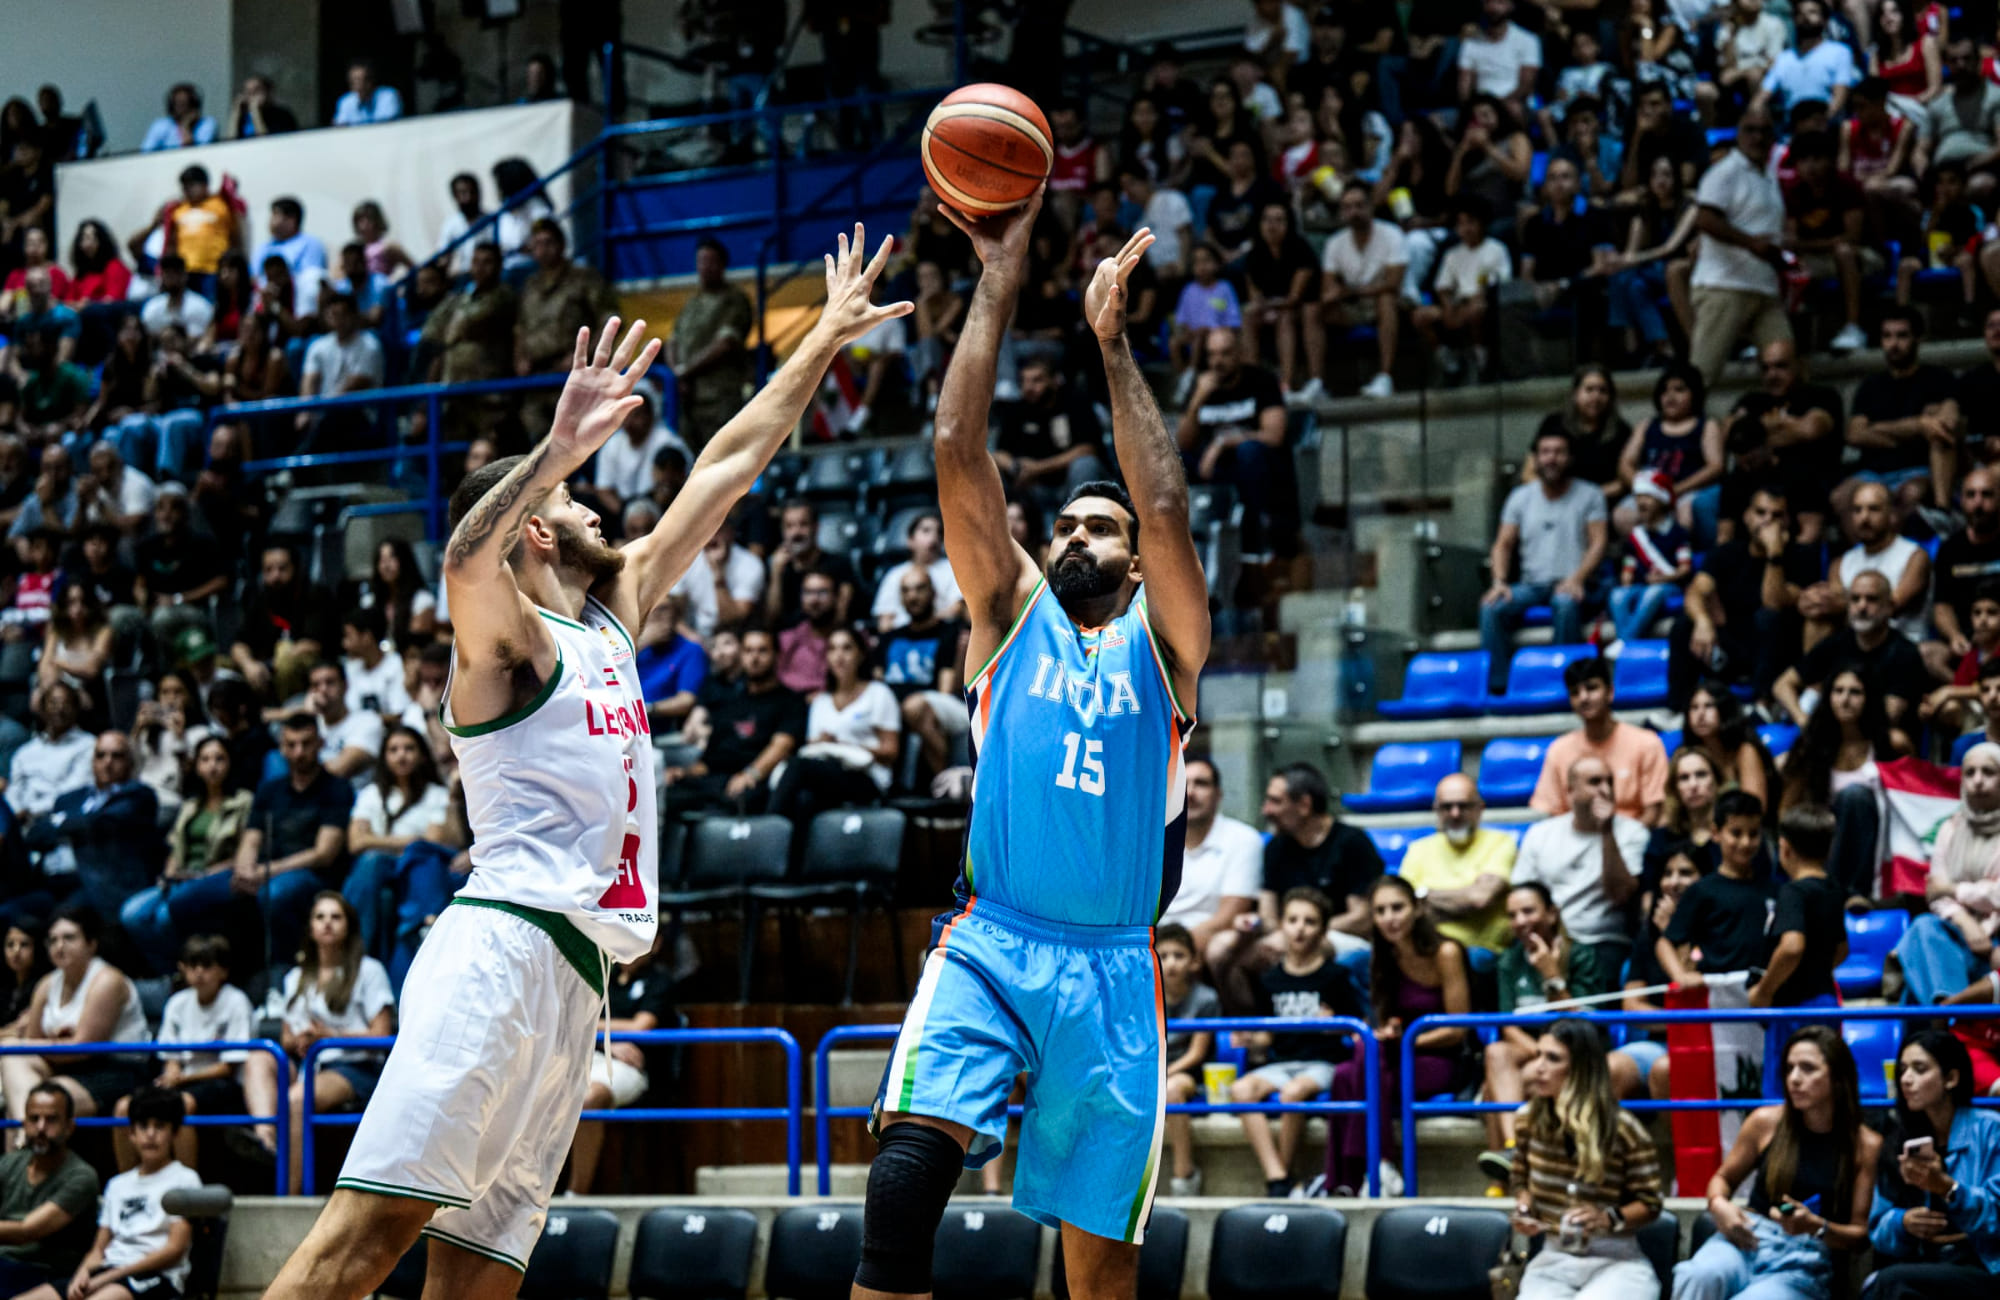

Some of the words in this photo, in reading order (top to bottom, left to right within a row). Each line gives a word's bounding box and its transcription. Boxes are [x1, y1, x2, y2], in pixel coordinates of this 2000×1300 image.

[1028, 652, 1142, 716] INDIA
[1055, 731, 1106, 796] 15
[618, 913, 655, 923] TRADE
[816, 1211, 841, 1232] 37
[1424, 1216, 1449, 1236] 41
